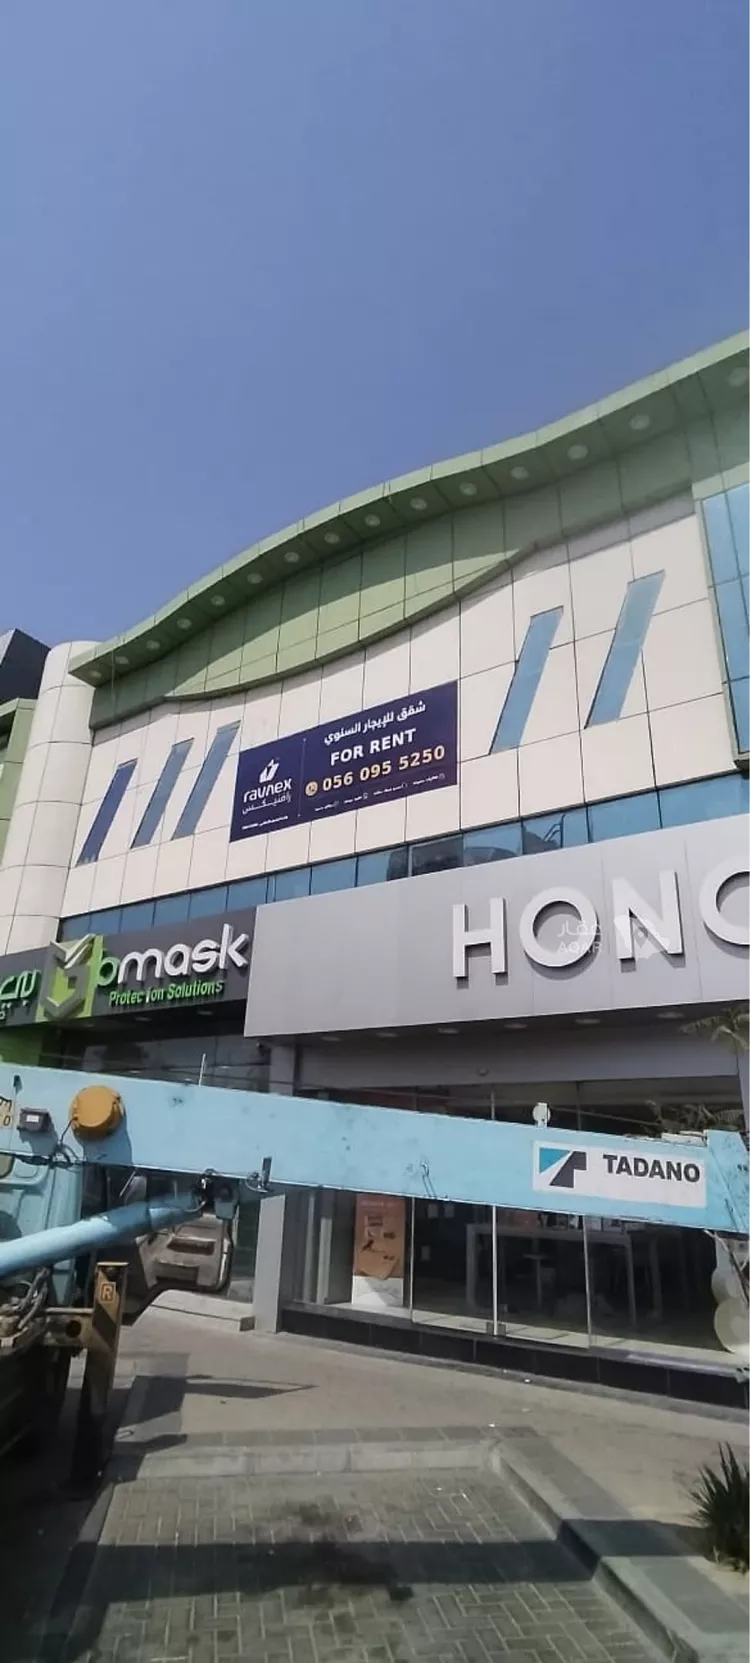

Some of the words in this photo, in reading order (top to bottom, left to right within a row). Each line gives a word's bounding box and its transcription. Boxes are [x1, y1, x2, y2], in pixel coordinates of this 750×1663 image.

[362, 711, 395, 734] للإيجار
[396, 700, 426, 722] شقق
[323, 722, 362, 746] السنوي
[330, 745, 364, 767] FOR
[369, 728, 417, 754] RENT
[322, 772, 353, 792] 056
[359, 760, 392, 781] 095
[398, 745, 445, 771] 5250
[166, 980, 224, 1000] Solutions
[603, 1154, 700, 1183] TADANO
